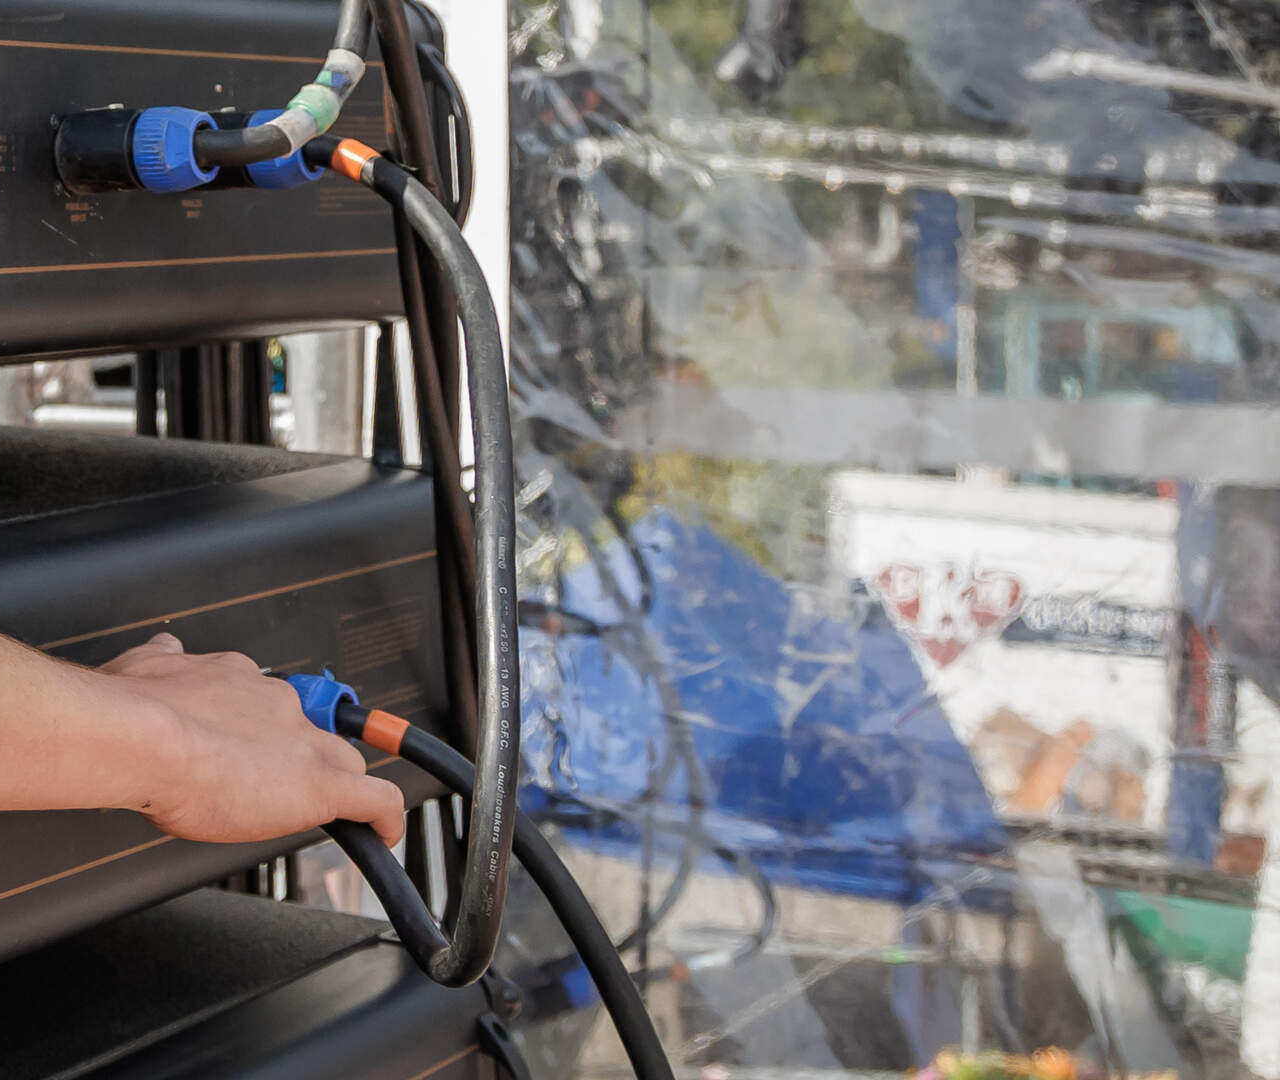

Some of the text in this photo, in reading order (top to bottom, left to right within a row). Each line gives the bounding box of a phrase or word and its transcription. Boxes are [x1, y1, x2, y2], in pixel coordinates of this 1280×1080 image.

[500, 668, 510, 679] 13
[501, 684, 510, 709] AWG
[492, 764, 507, 844] Loudspeakers
[488, 850, 500, 881] Cable
